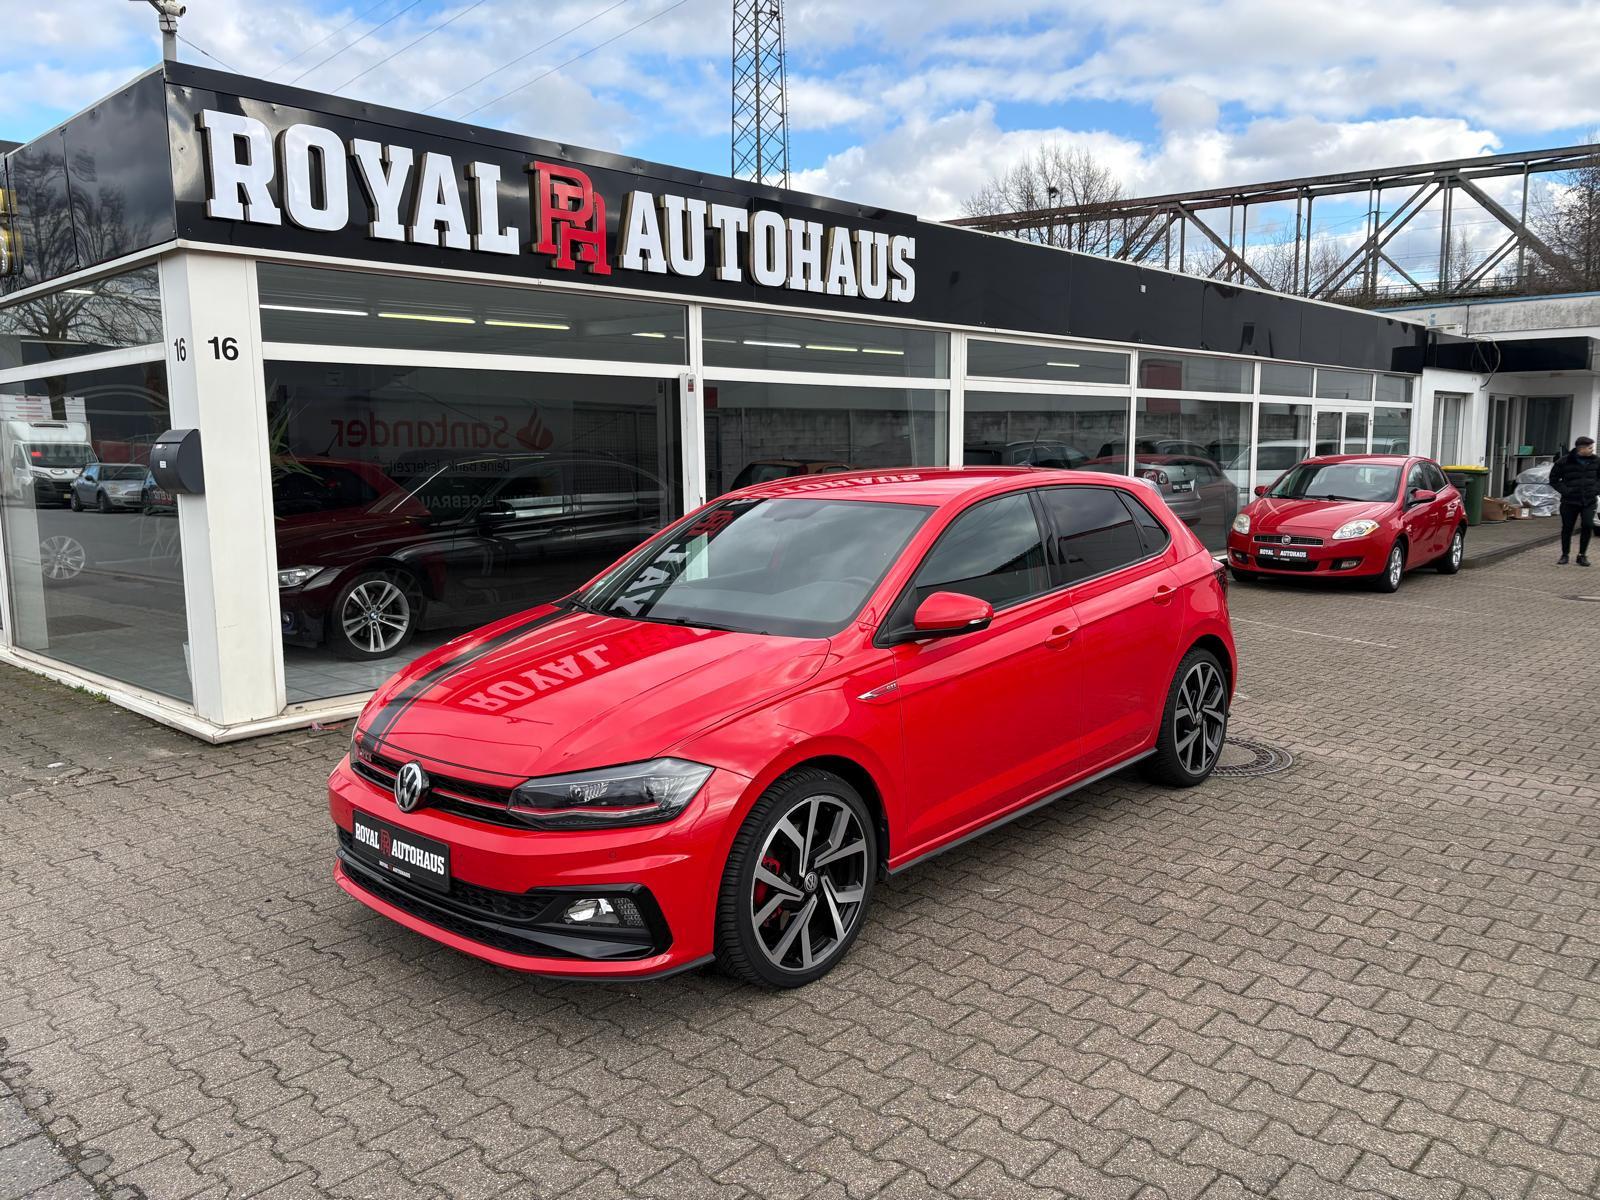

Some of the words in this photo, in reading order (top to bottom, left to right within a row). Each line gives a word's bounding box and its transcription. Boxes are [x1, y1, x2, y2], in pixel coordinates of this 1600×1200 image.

[199, 108, 520, 256] ROYAL
[619, 190, 916, 303] AUTOHAUS
[174, 337, 187, 362] 16
[208, 336, 239, 361] 16
[355, 823, 380, 850] ROYAL
[391, 839, 445, 875] AUTOHAUS
